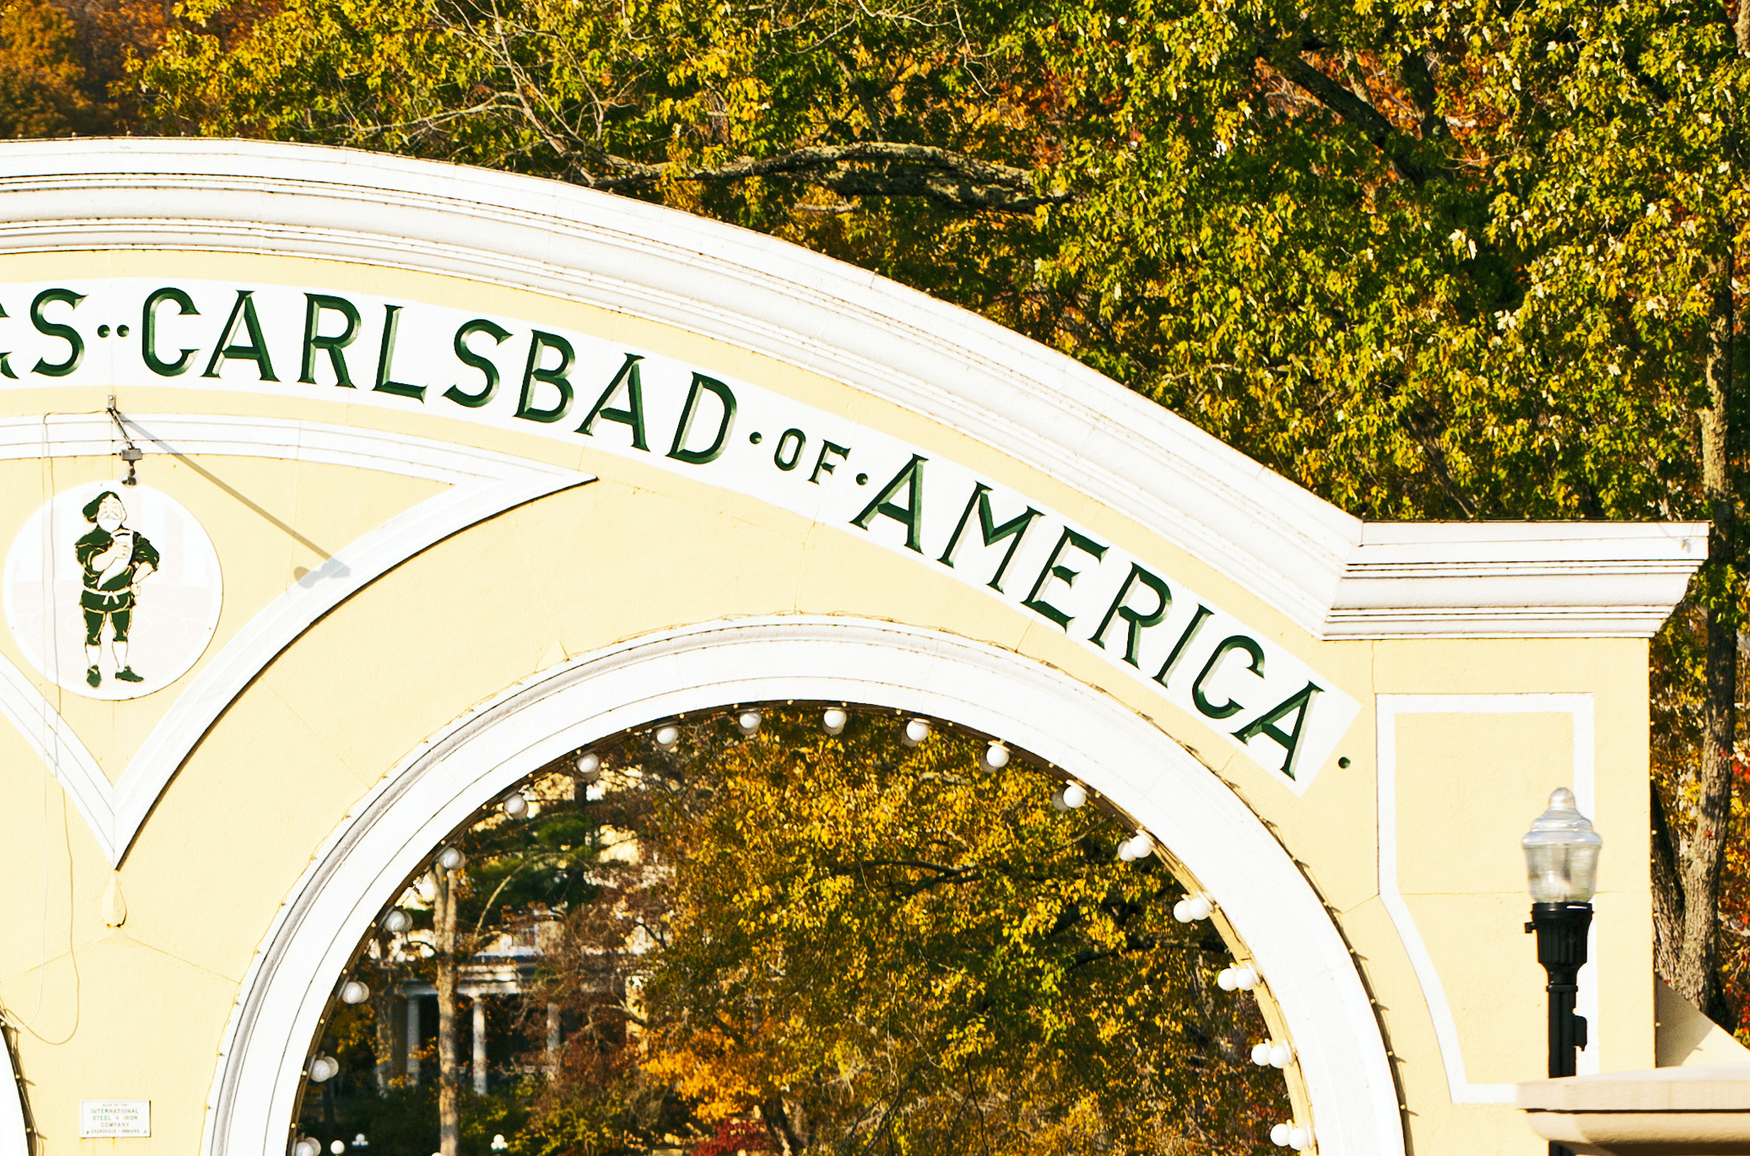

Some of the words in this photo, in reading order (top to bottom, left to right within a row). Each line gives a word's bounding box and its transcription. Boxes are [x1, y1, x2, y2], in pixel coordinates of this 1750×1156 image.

[141, 287, 738, 465] CARLSBAD
[773, 427, 852, 485] OF
[848, 453, 1326, 782] AMERICA
